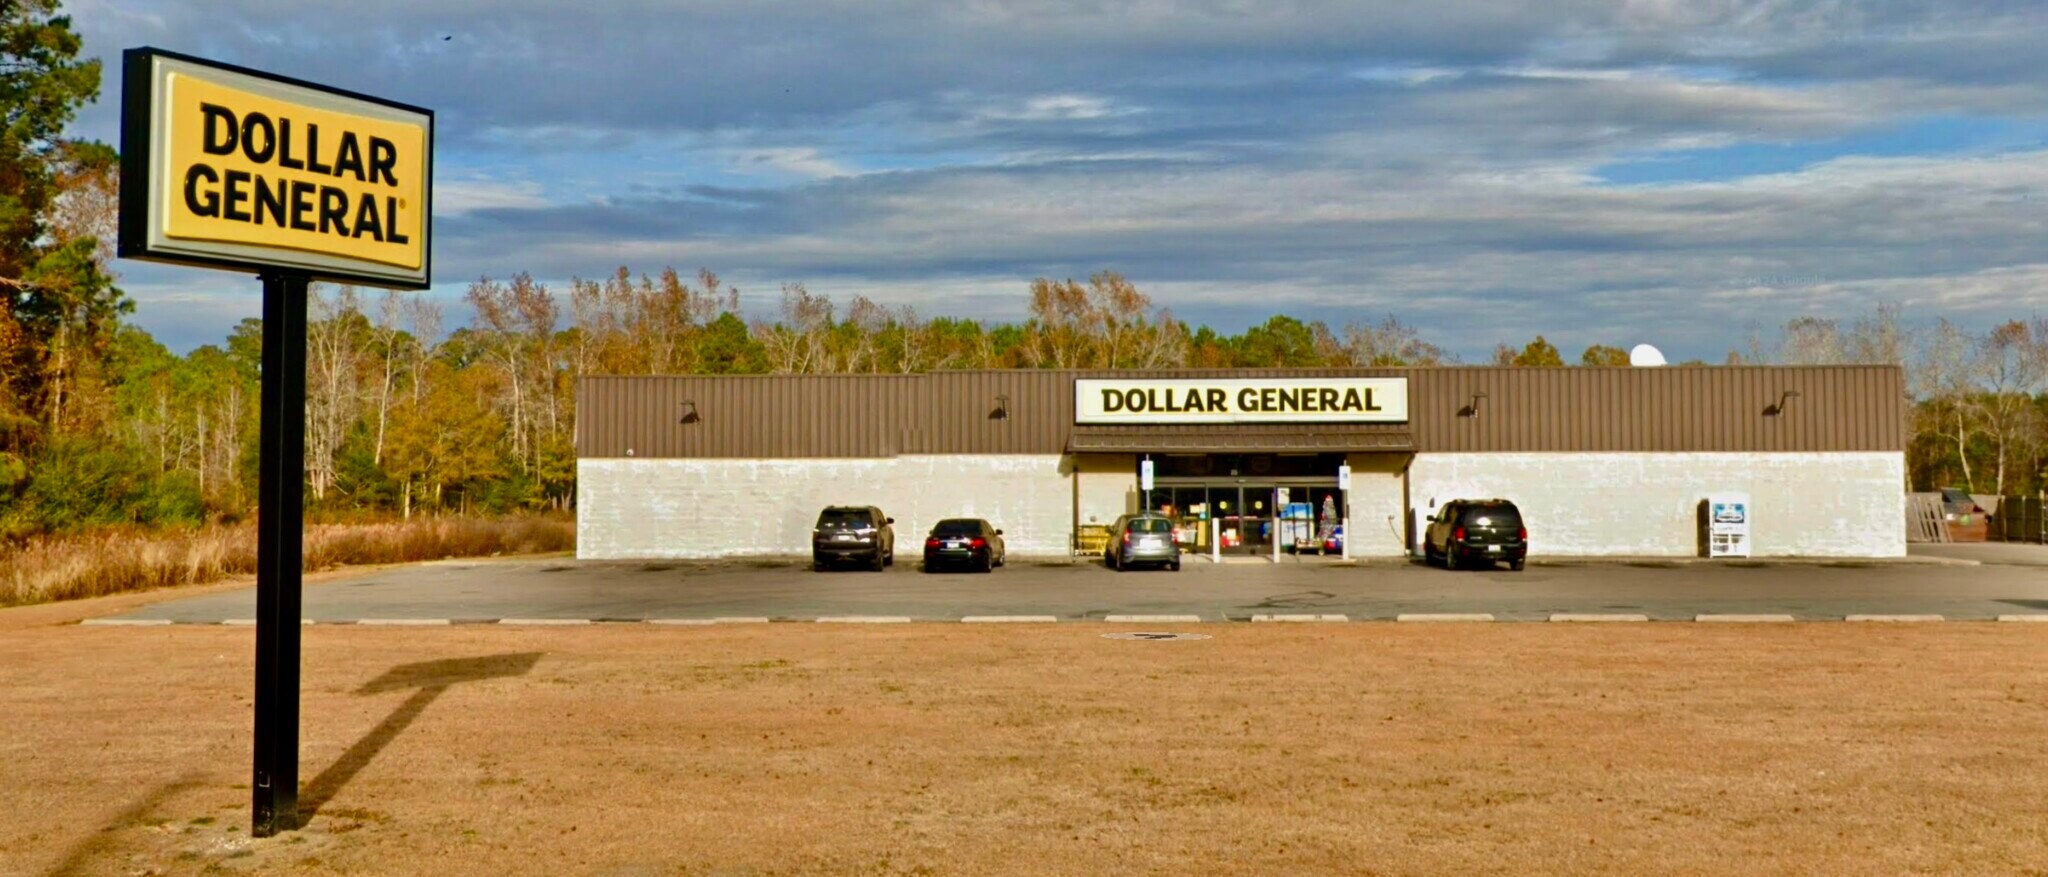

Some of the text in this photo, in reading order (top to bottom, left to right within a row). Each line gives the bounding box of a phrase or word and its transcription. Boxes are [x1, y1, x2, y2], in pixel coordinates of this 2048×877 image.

[201, 102, 398, 187] DOLLAR
[184, 163, 409, 245] GENERAL
[1101, 388, 1382, 413] DOLLAR GENERAL
